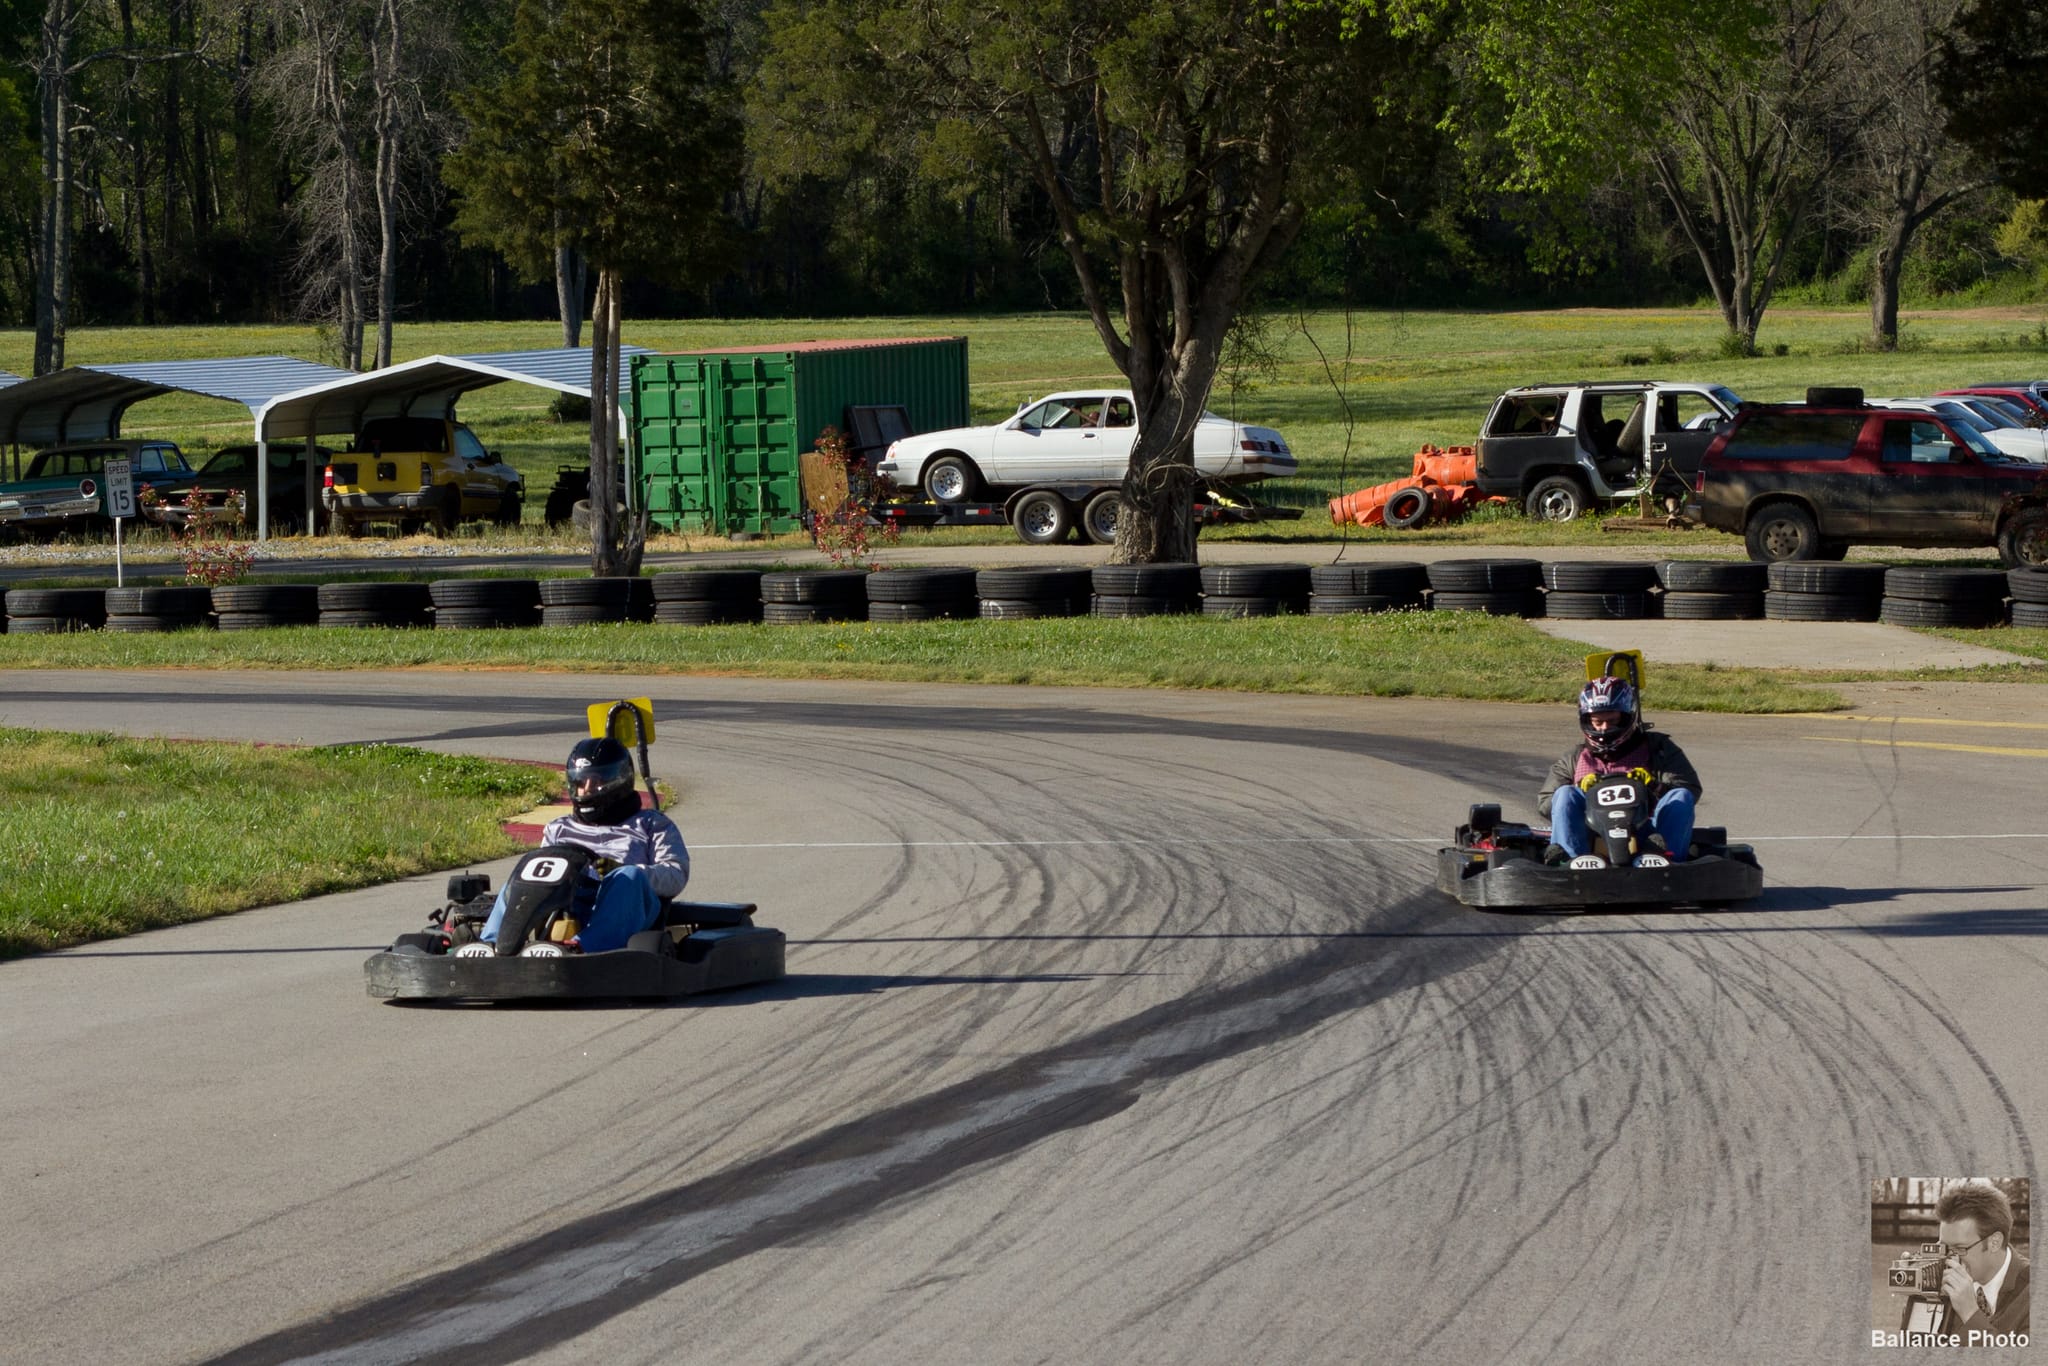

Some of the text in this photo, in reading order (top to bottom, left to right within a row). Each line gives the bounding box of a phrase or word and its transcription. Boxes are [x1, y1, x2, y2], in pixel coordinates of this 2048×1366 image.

[108, 465, 129, 474] SPEED
[110, 478, 128, 486] LIMIT
[112, 490, 130, 511] 15
[1601, 787, 1632, 802] 34
[1575, 860, 1599, 868] VIR
[1640, 859, 1662, 867] VIR
[532, 860, 555, 878] 6
